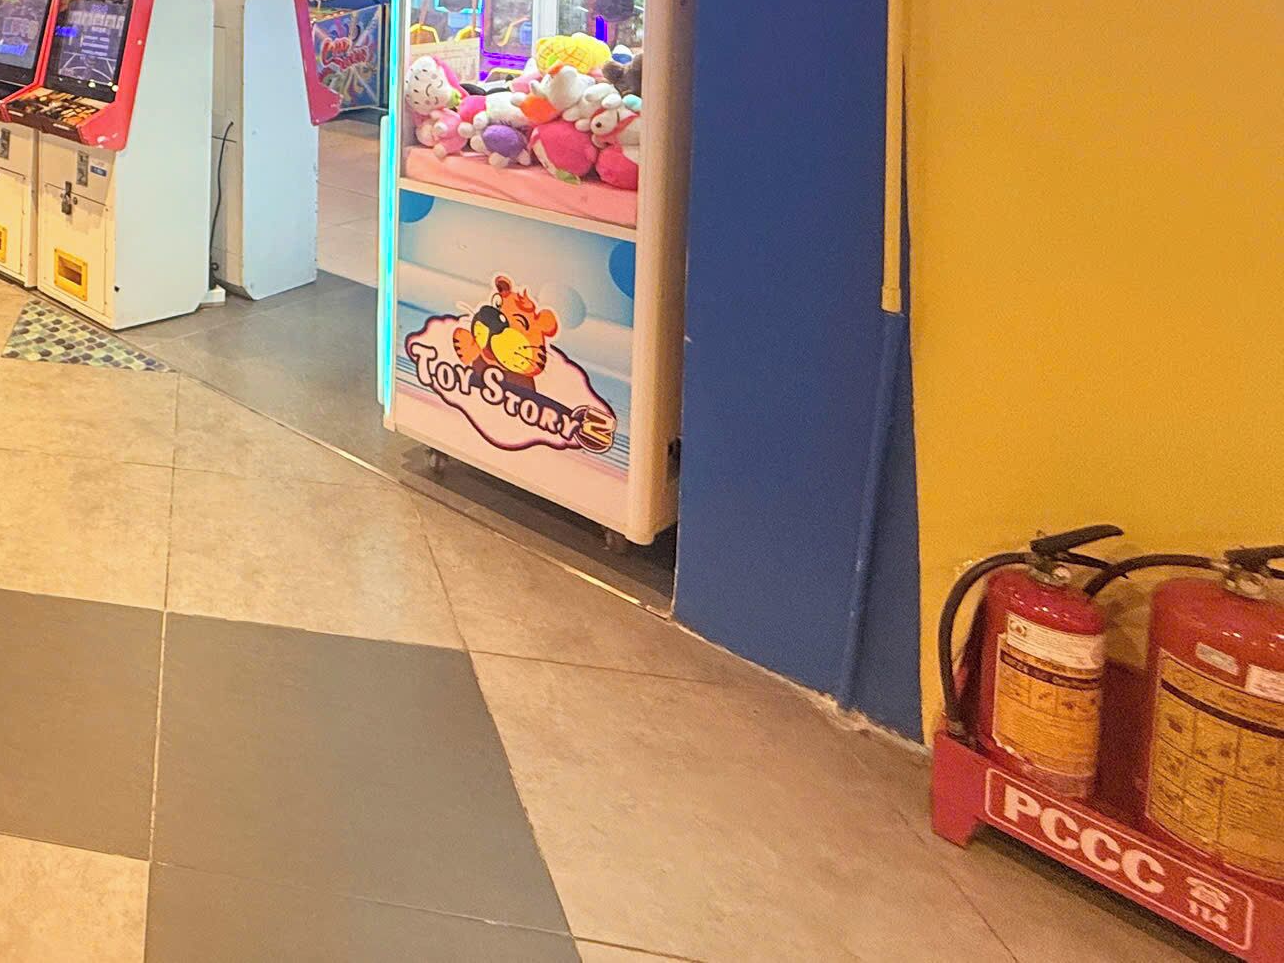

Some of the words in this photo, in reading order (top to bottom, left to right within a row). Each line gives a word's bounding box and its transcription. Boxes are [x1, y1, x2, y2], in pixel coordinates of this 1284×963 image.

[411, 343, 473, 395] TOY
[480, 365, 580, 442] STORY
[1003, 784, 1166, 895] PCCC
